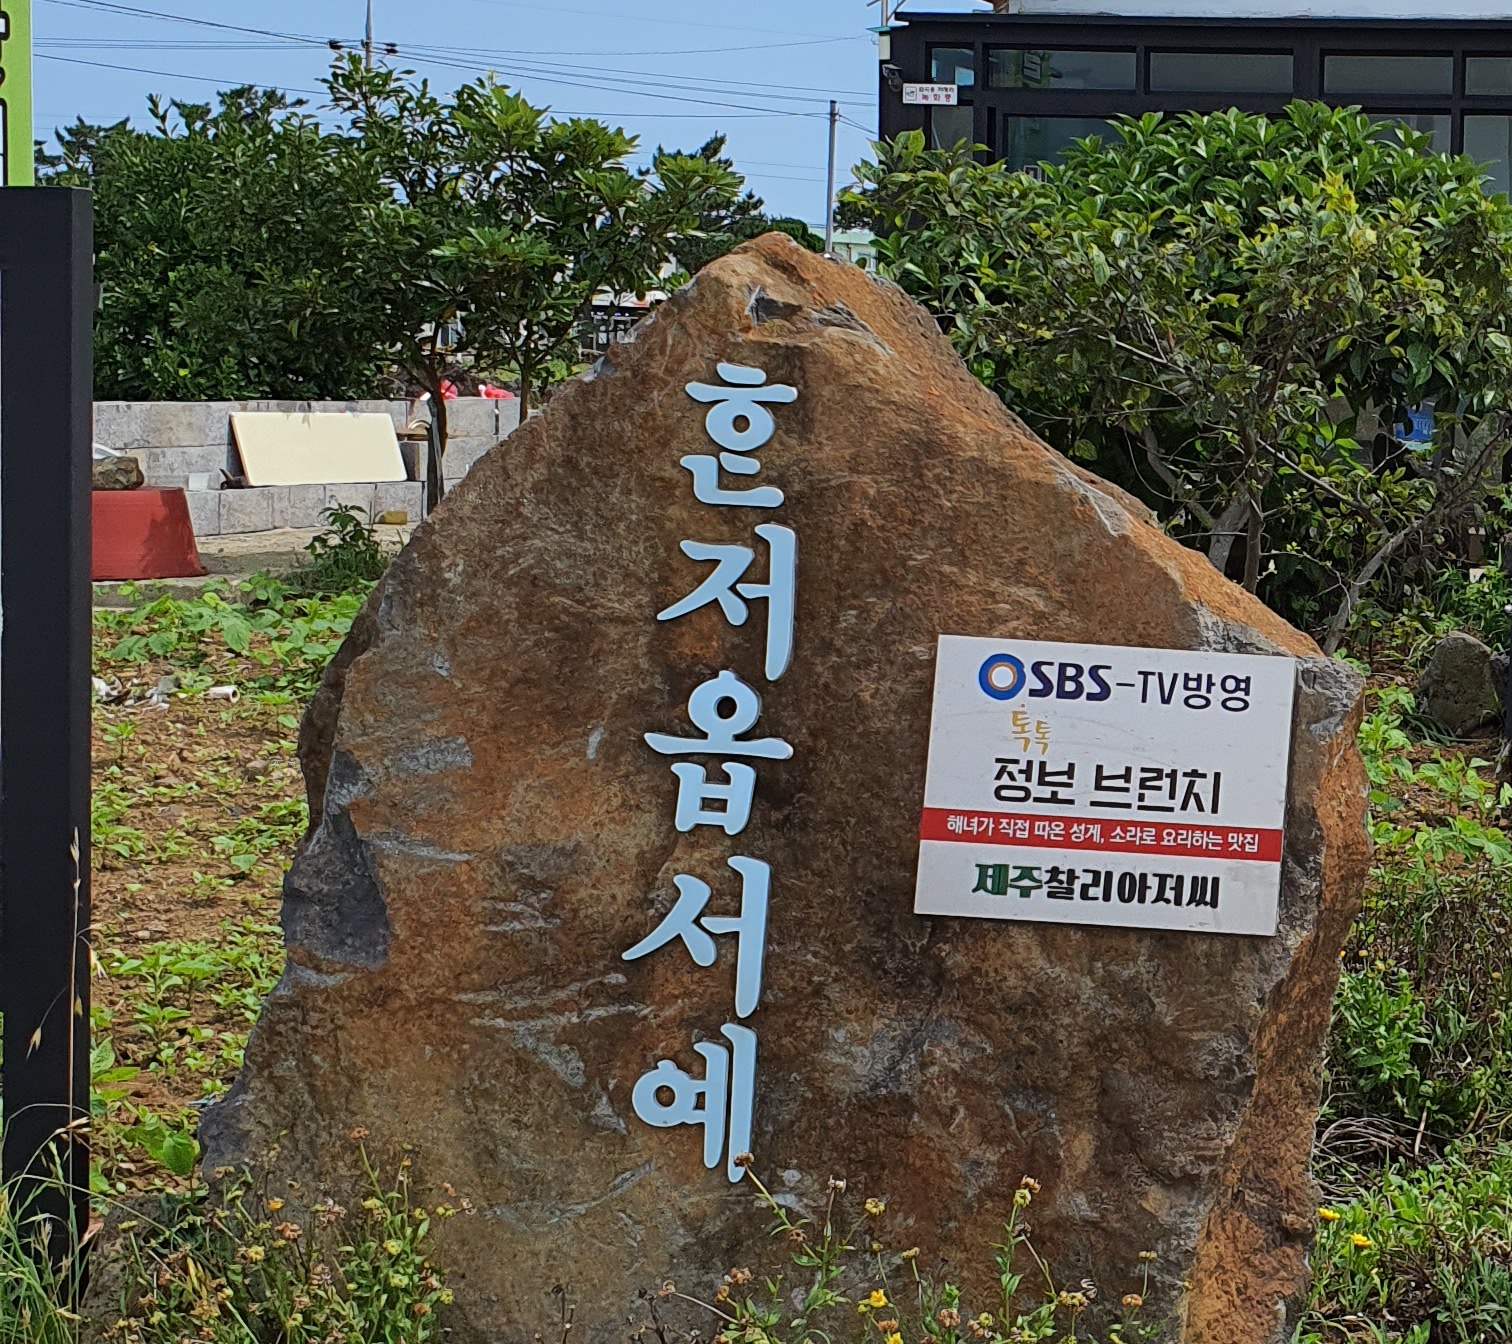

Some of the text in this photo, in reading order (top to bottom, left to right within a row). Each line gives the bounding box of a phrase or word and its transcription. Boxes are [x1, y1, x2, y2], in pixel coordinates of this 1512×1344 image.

[1028, 660, 1252, 713] SBS-TV방영
[1011, 704, 1052, 756] 톡톡
[992, 757, 1222, 815] 정보 브런치
[946, 814, 1259, 854] 해녀가 직접 따온 성게, 소라로 요리하는 맛집
[971, 862, 1221, 910] 제주찰리아저씨
